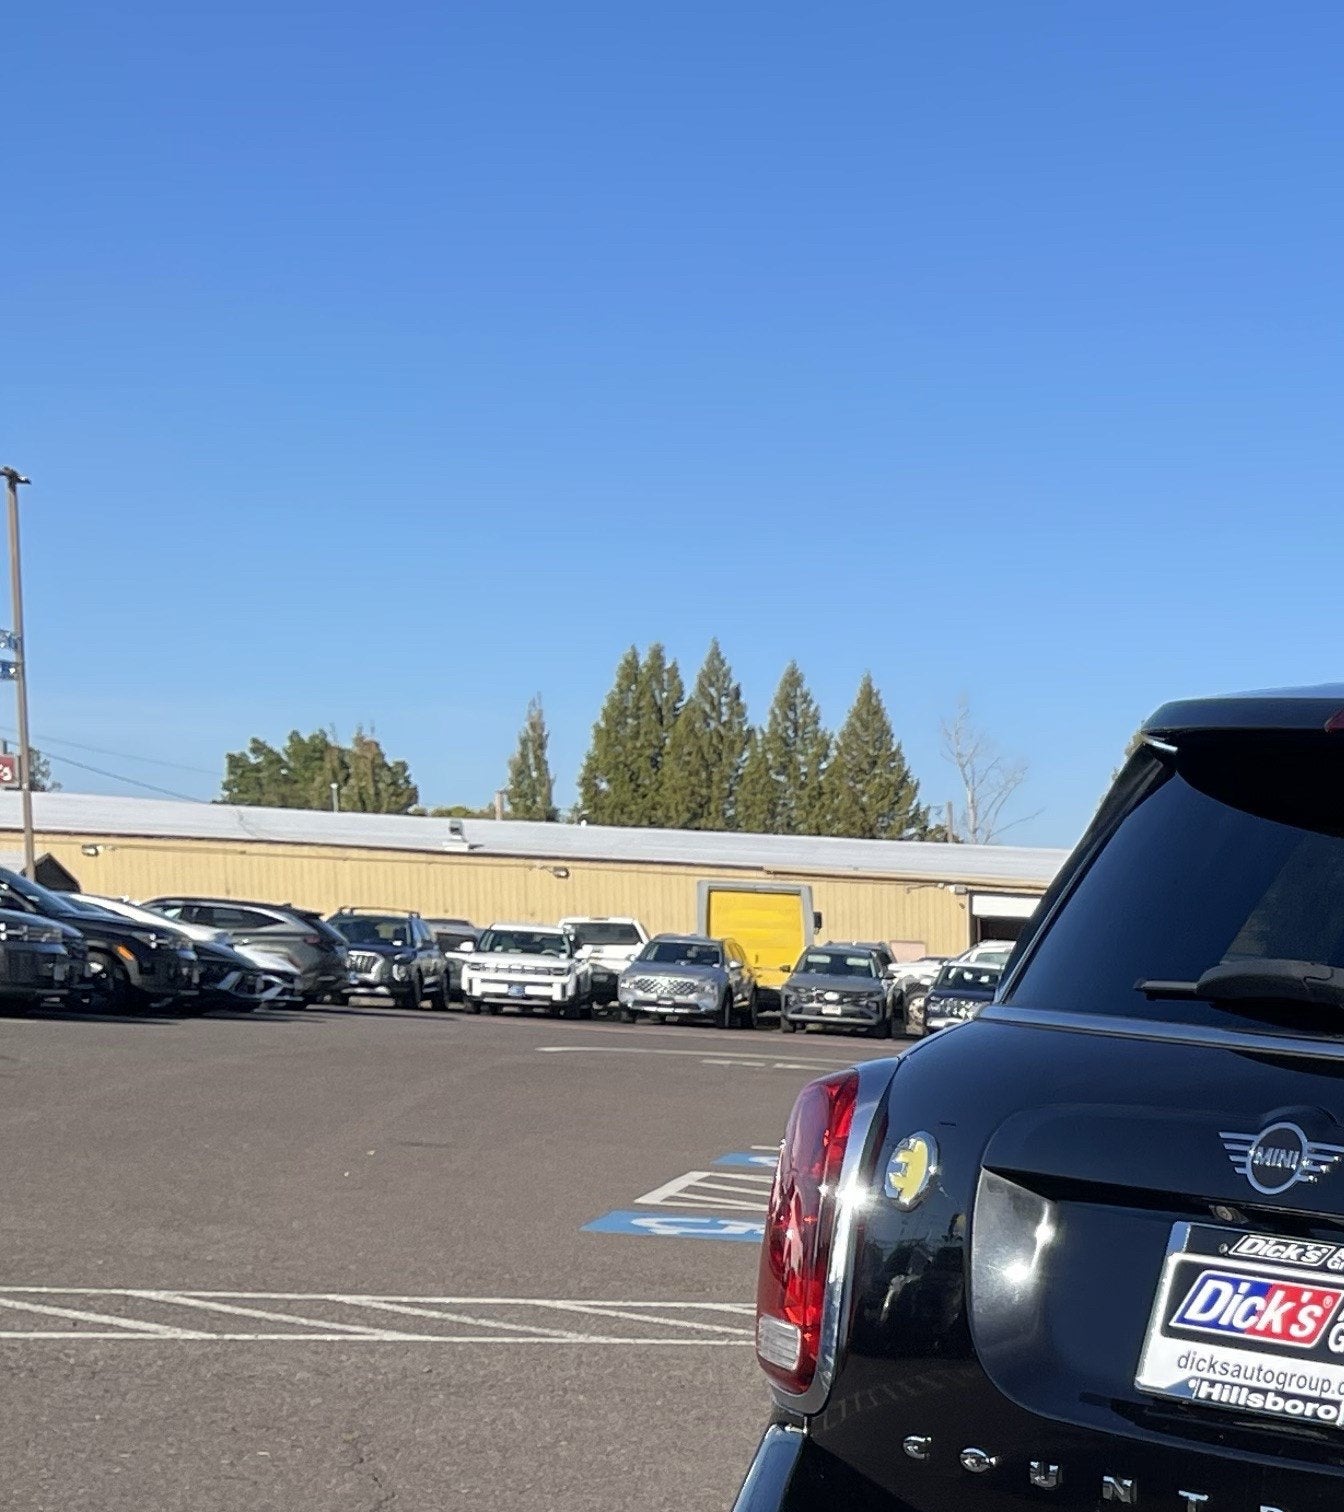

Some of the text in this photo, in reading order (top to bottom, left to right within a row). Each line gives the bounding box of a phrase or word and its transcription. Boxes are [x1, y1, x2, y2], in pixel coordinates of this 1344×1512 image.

[1254, 1147, 1300, 1169] MINI
[1236, 1236, 1322, 1263] Dick's
[1183, 1278, 1326, 1339] Dick's
[1198, 1379, 1339, 1420] Hillsboro
